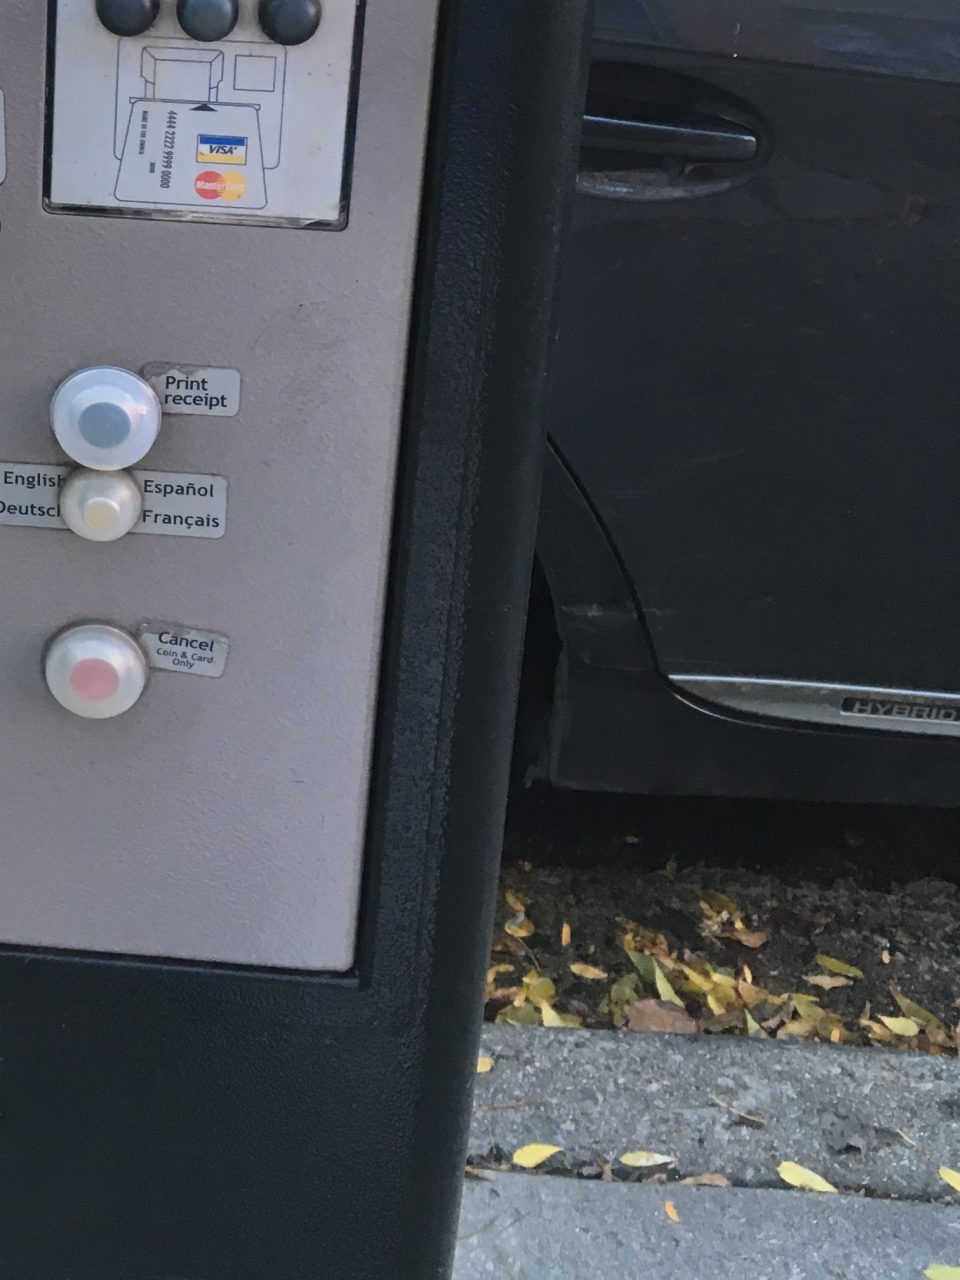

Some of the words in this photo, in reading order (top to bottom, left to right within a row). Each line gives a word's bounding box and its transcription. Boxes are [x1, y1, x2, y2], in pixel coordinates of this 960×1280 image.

[167, 110, 177, 129] 4444
[165, 130, 175, 150] 2222
[162, 151, 173, 169] 9999
[160, 170, 171, 188] 0000
[165, 376, 208, 391] Print
[165, 393, 227, 410] receipt
[144, 480, 214, 497] Español
[143, 511, 219, 528] Français
[158, 632, 214, 652] Cancel
[156, 648, 177, 658] Coin
[191, 653, 213, 663] Card
[172, 658, 195, 669] Only
[853, 701, 957, 720] HYBRID
